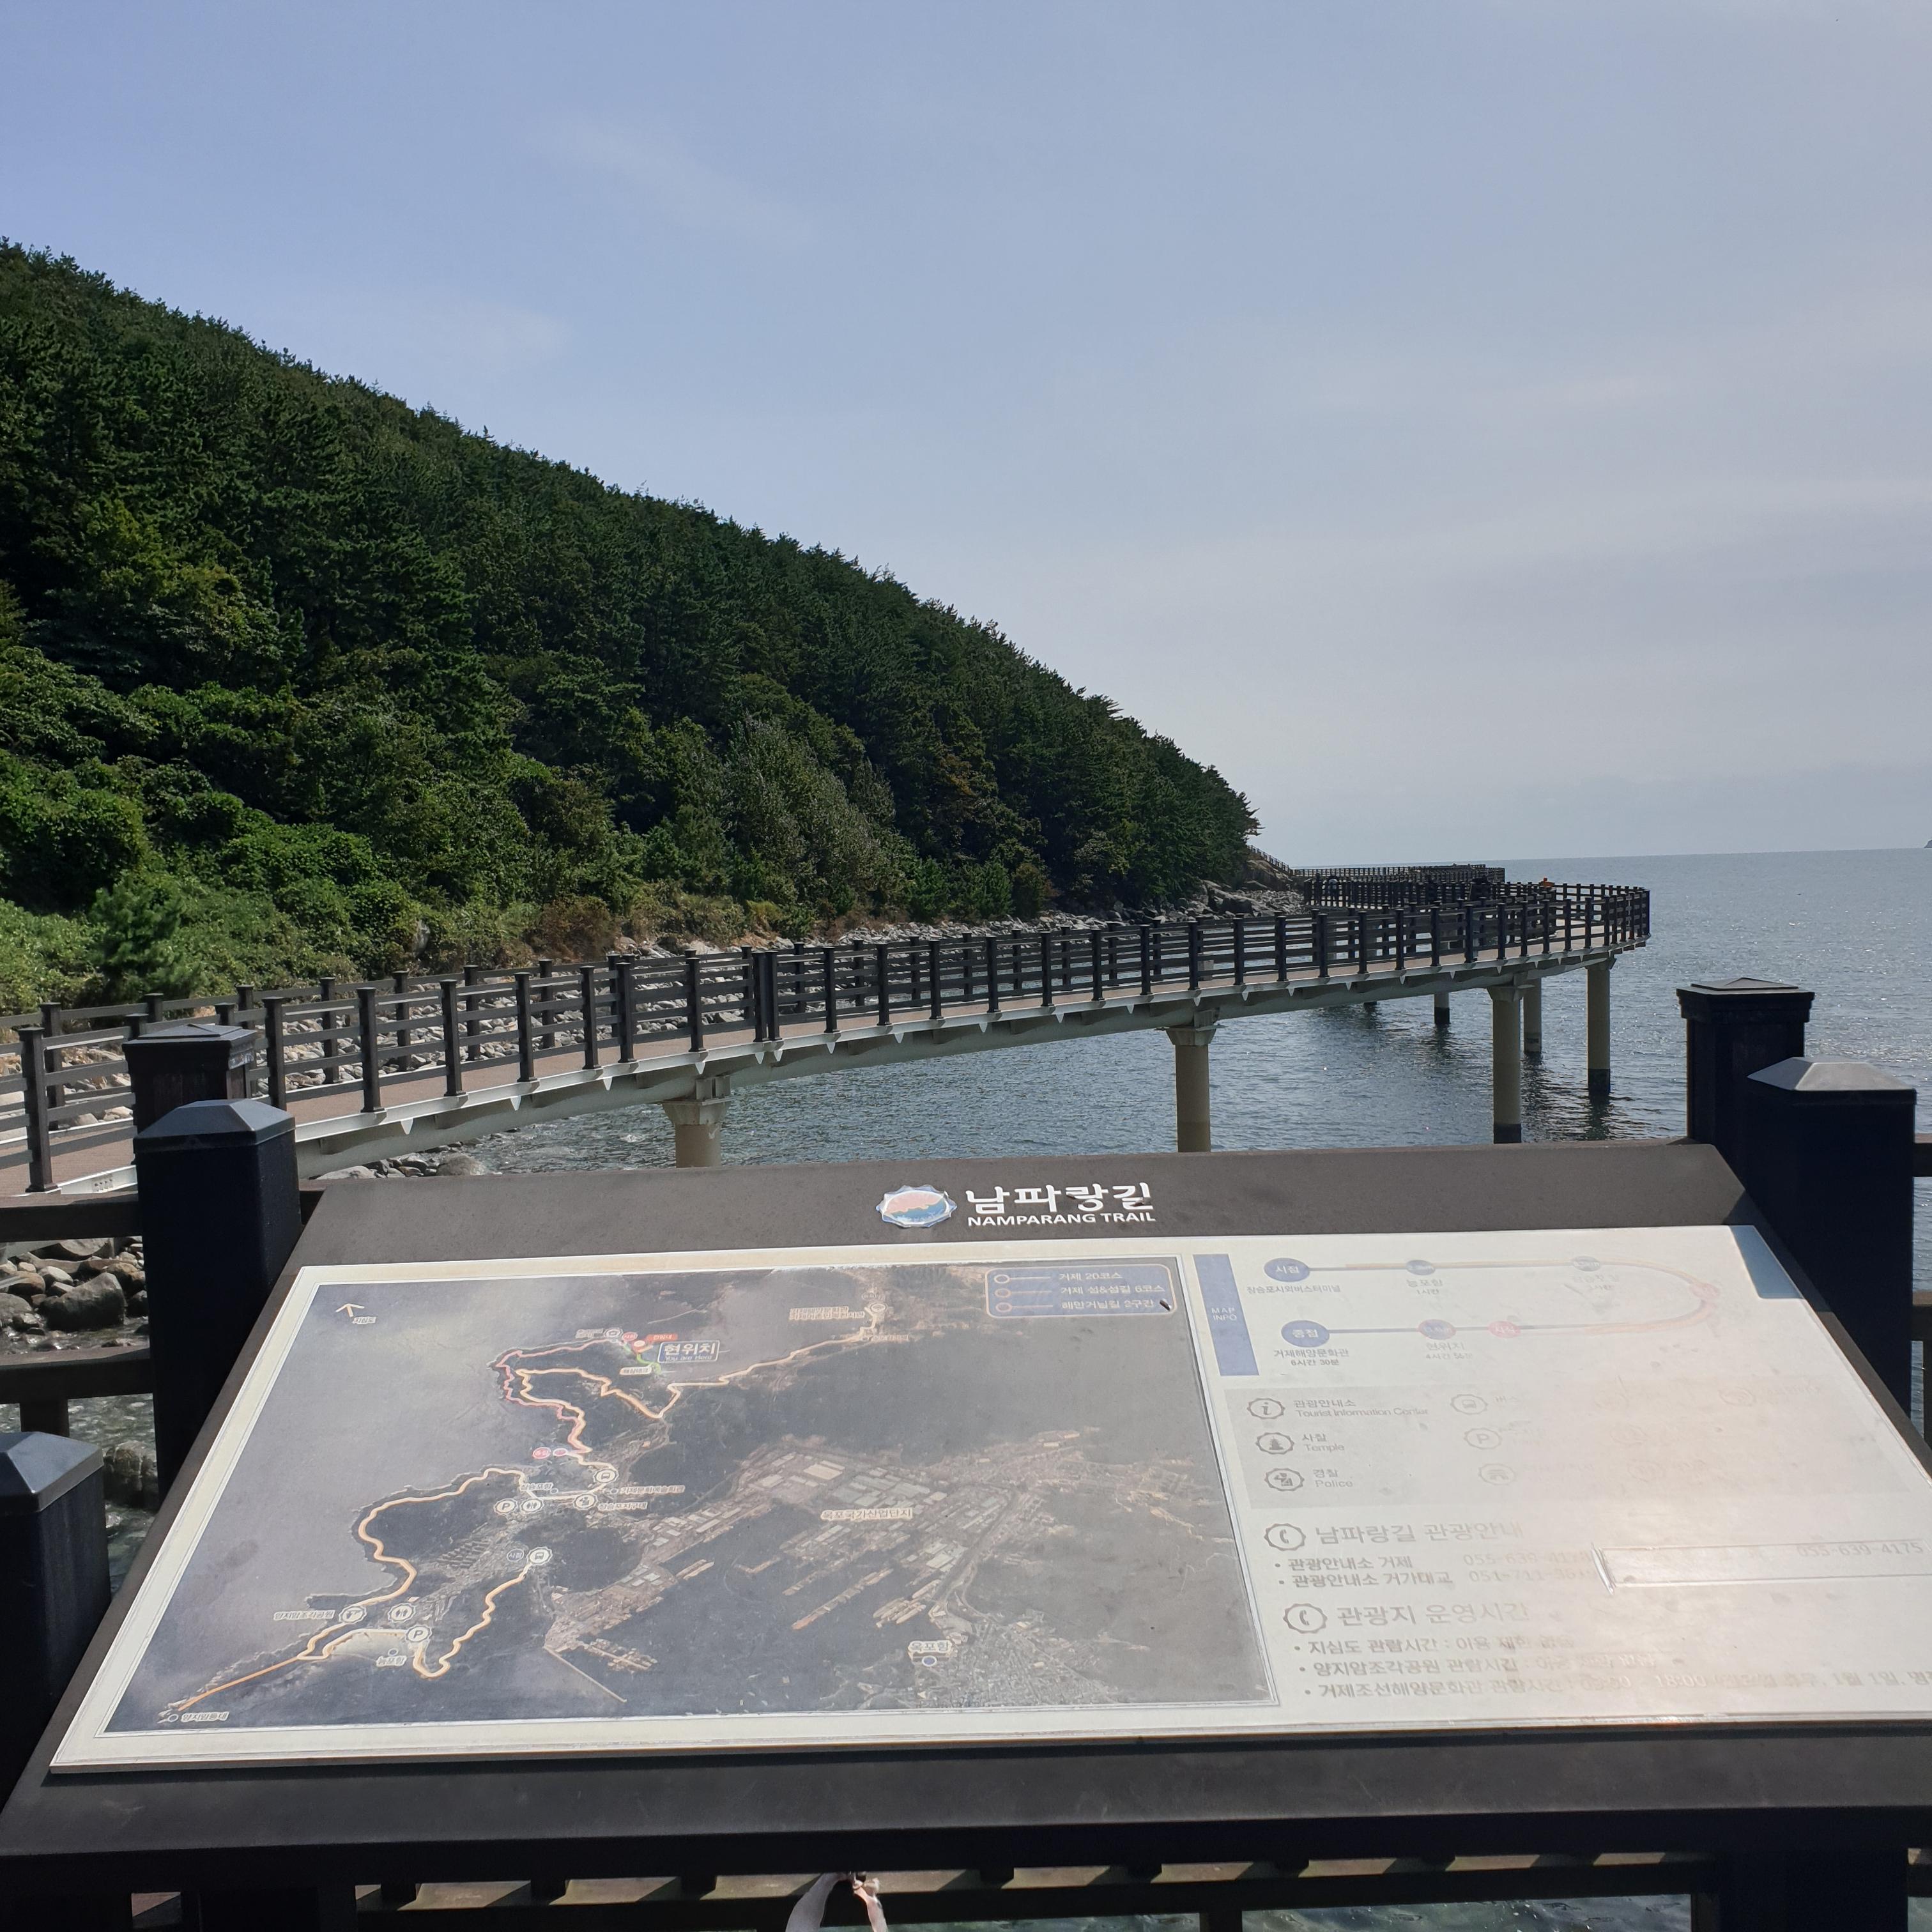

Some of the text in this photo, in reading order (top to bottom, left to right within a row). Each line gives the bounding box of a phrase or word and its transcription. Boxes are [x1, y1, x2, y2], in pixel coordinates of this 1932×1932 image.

[965, 1182, 1154, 1214] 남파랑길
[967, 1212, 1156, 1227] NAMPARANG TRAIL
[1059, 1272, 1123, 1281] 거제 20코스
[1275, 1264, 1300, 1275] 시점
[1061, 1286, 1084, 1296] 거제
[664, 1342, 716, 1356] 현위치
[1294, 1399, 1356, 1408] 관광안내소
[1296, 1409, 1332, 1418] Tourist
[1335, 1408, 1391, 1417] Information
[1476, 1434, 1490, 1445] P
[1305, 1443, 1345, 1453] Temple
[1315, 1479, 1353, 1487] Police
[824, 1508, 912, 1520] 옥포국가산업단지
[1314, 1524, 1417, 1545] 남파랑길
[1797, 1542, 1924, 1558] 055-639-4175
[1288, 1557, 1374, 1571] 관광안내소
[1380, 1556, 1413, 1569] 거제
[1292, 1574, 1379, 1588] 관광안내소
[1386, 1571, 1453, 1586] 거가대교
[1337, 1602, 1531, 1627] 관광지 운영시간
[1308, 1641, 1364, 1655] 지심도
[1367, 1638, 1438, 1653] 관람시간
[1457, 1636, 1491, 1651] 이용
[1313, 1660, 1441, 1678] 양지암조각공원
[1318, 1680, 1484, 1699] 거제조선해양문화관
